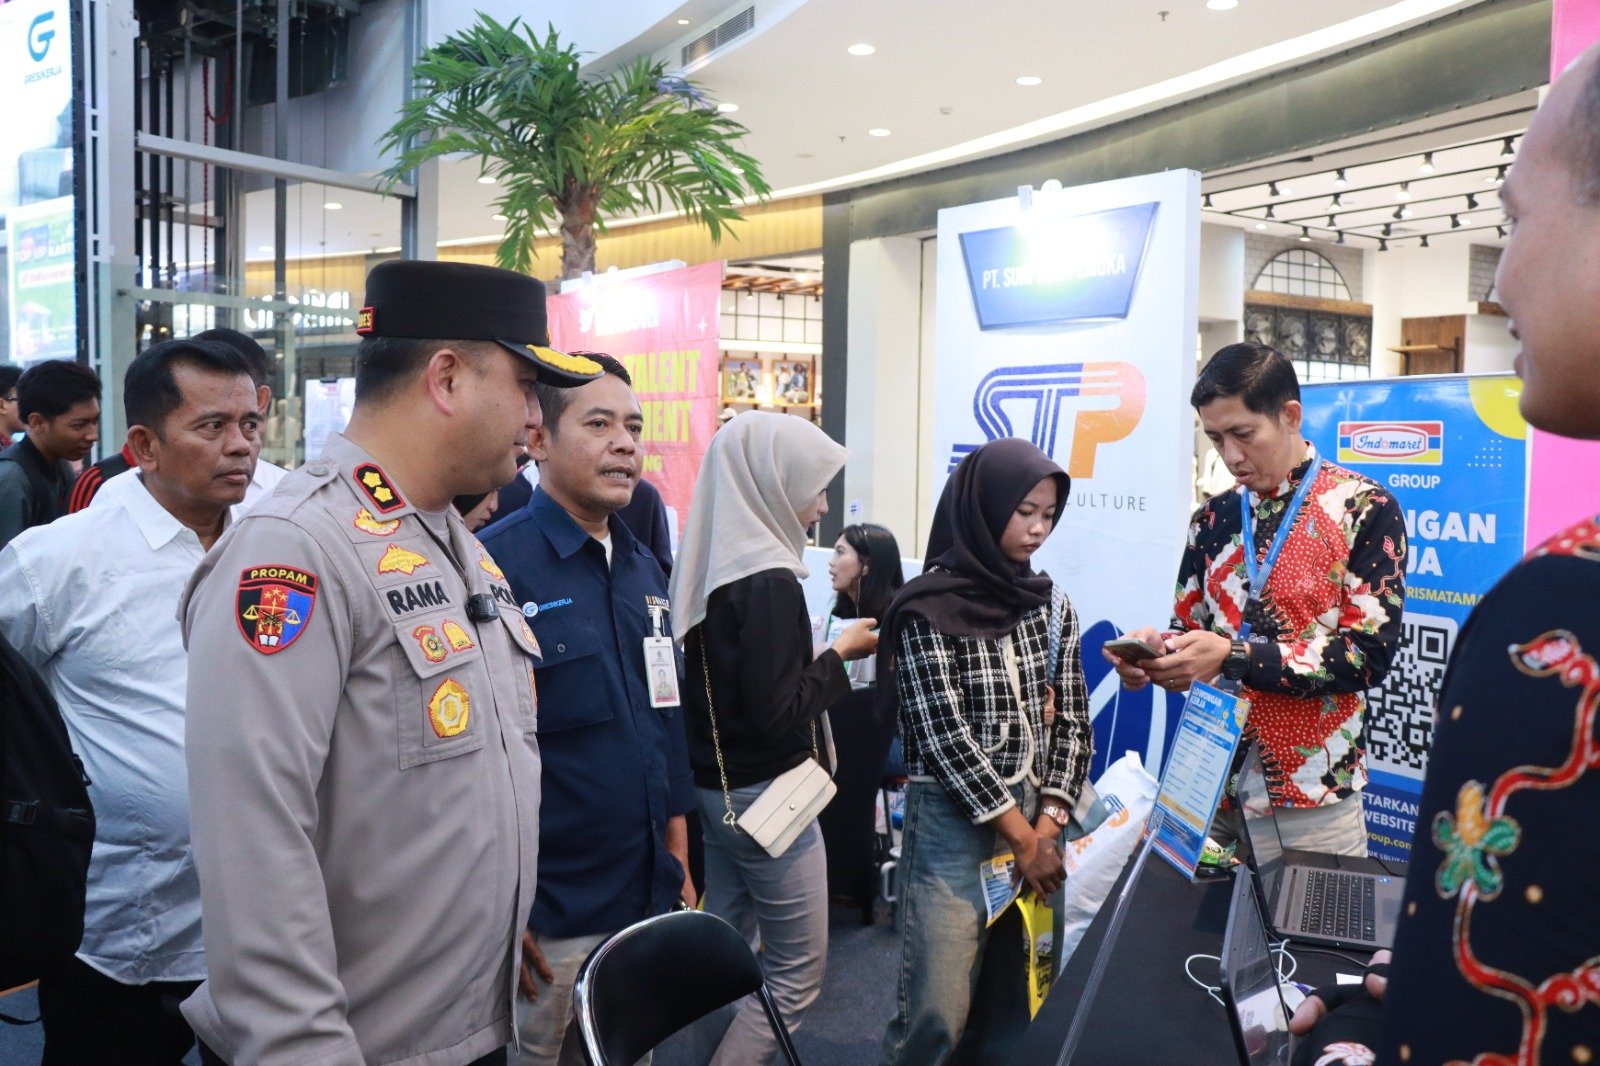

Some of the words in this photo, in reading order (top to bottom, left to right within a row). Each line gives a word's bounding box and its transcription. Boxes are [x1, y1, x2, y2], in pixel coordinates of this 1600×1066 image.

[982, 269, 1001, 289] PT.
[624, 349, 700, 394] TALENT
[1357, 435, 1422, 449] Indomaret
[1388, 473, 1441, 489] GROUP
[1067, 493, 1146, 512] ULTURE
[250, 568, 308, 585] PROPAM
[386, 580, 451, 615] RAMA
